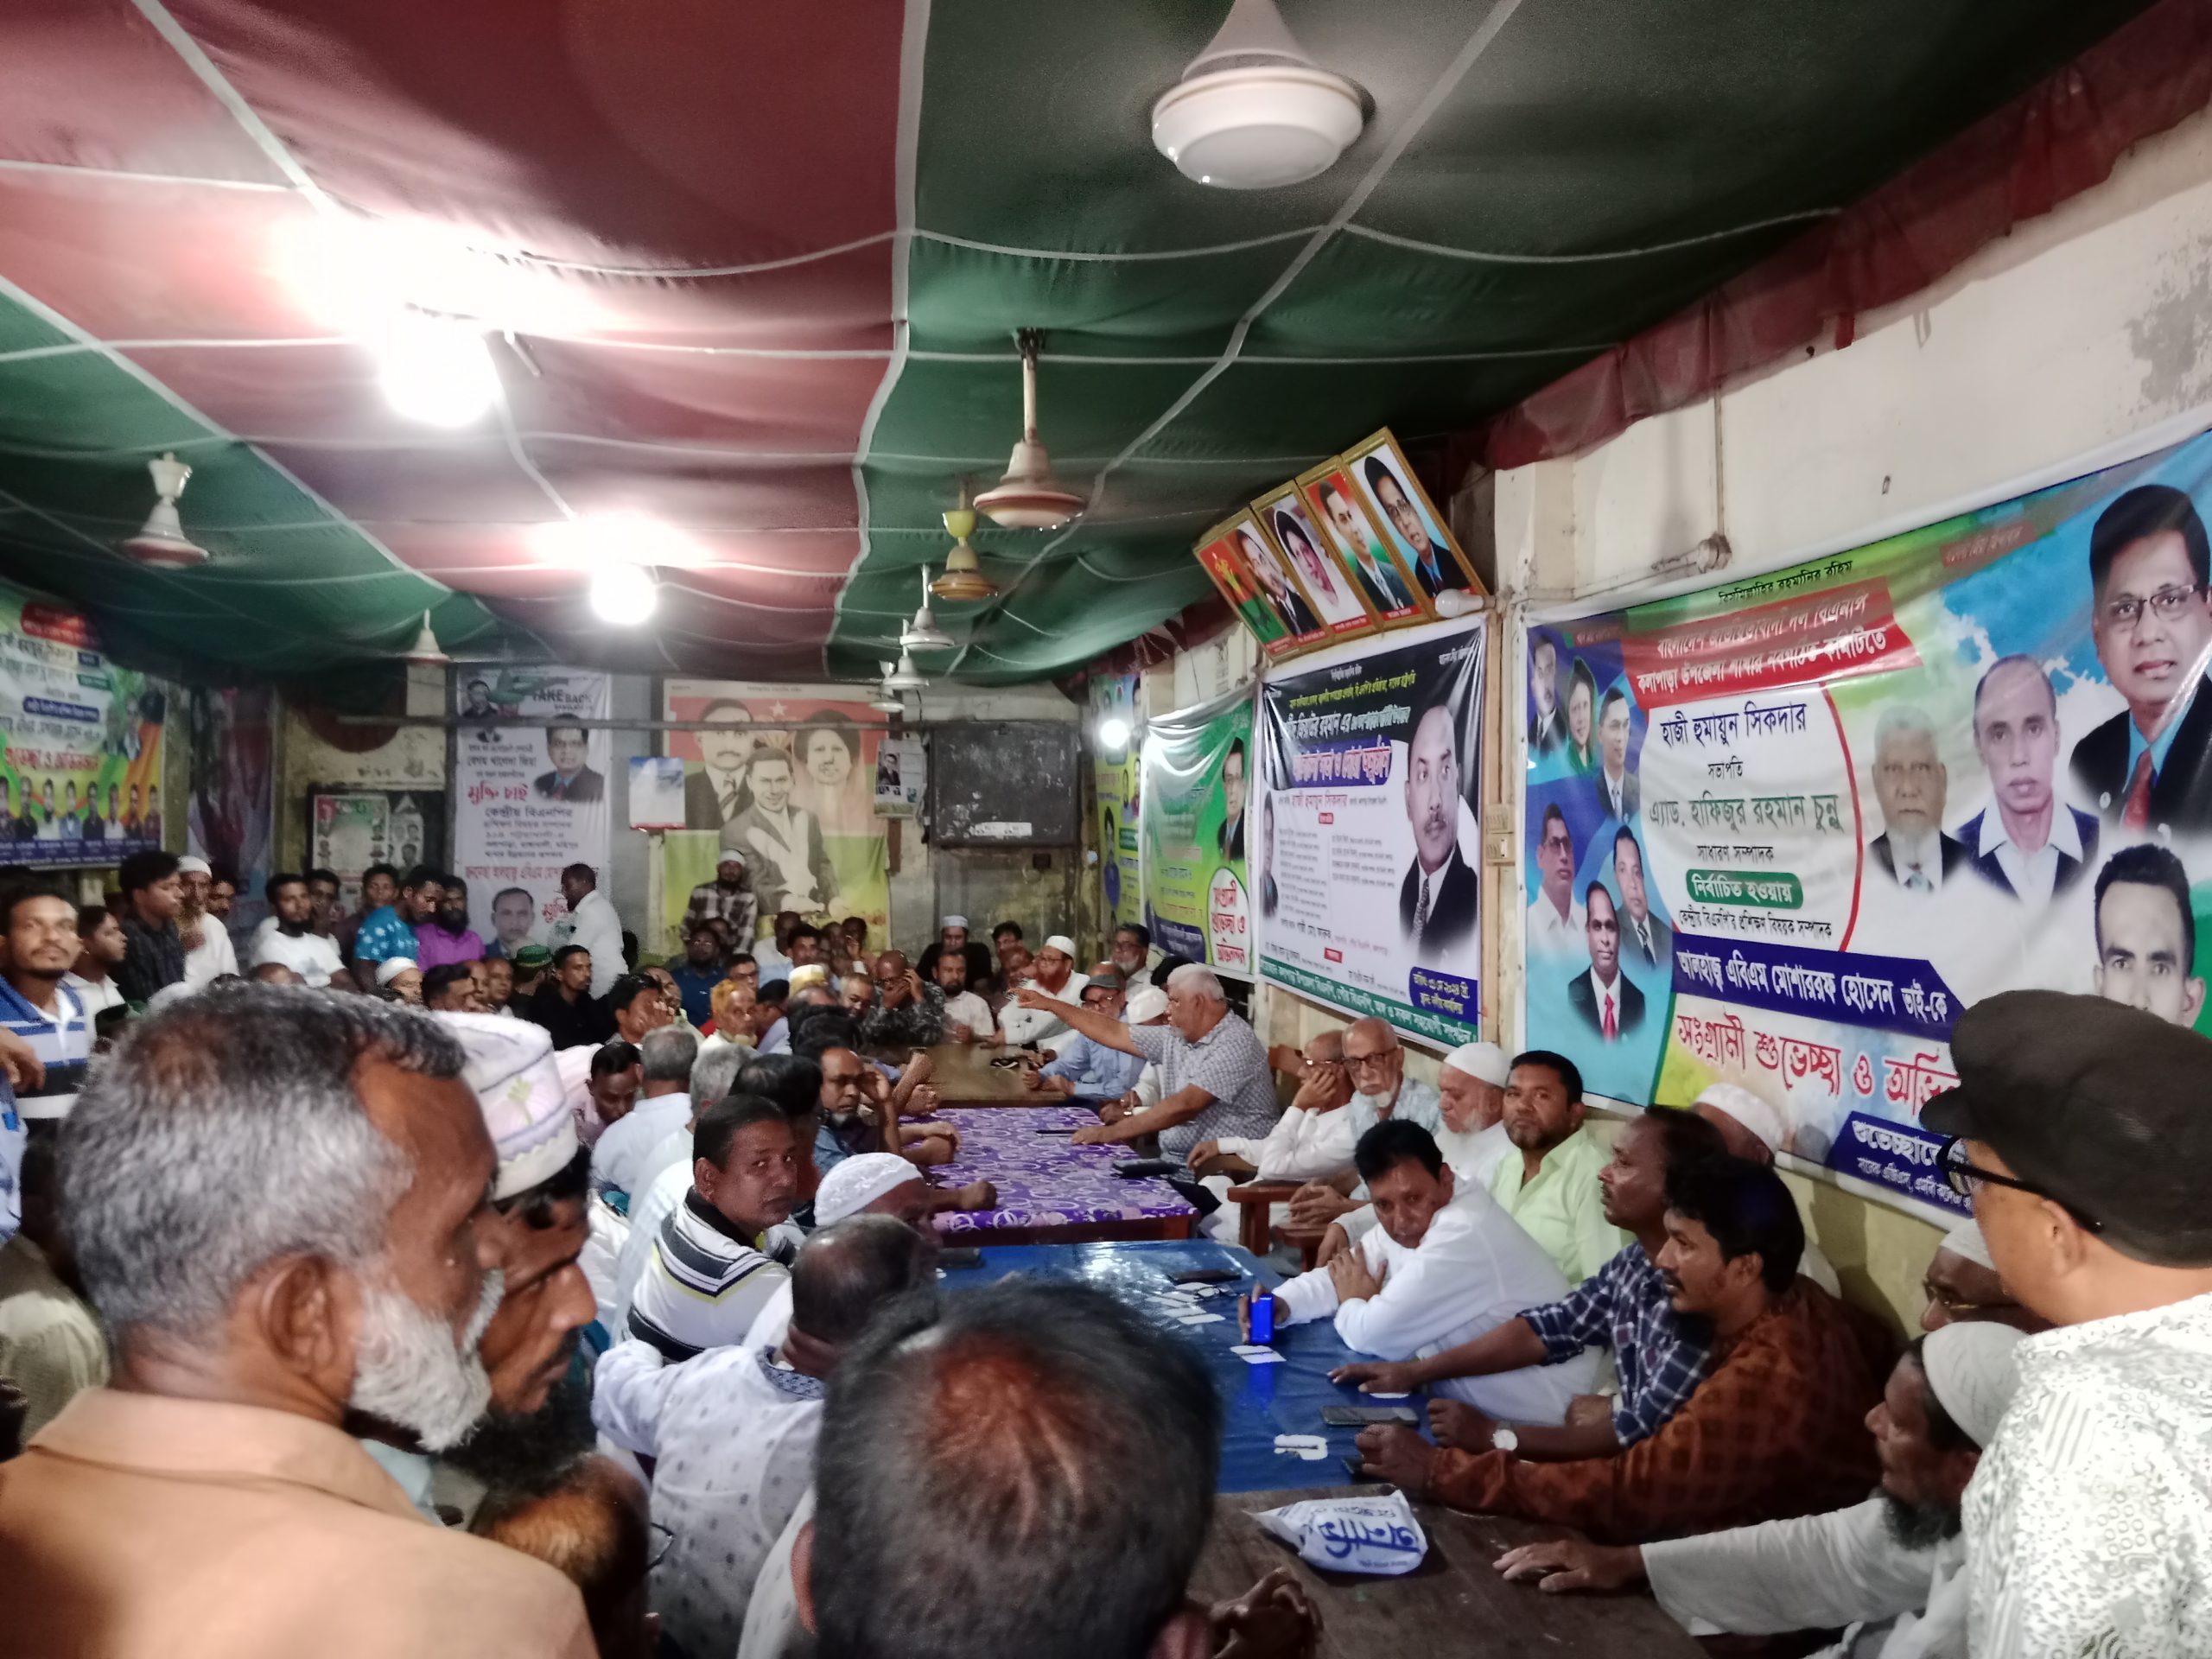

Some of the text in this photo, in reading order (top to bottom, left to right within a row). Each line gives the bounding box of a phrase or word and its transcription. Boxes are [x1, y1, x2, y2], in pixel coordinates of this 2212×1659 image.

[1660, 700, 1808, 748] হাজী হুমায়ুন সিকদার
[1707, 755, 1744, 781] সভাপতি
[504, 783, 528, 802] চাই
[1688, 790, 1746, 835] হাফিজুর
[1751, 792, 1806, 830] রহমান
[1696, 844, 1774, 864] সাধারণ সম্পাদক
[1691, 872, 1793, 904] নির্বাচিত হওয়ায়
[1797, 918, 1832, 941] সম্পাদক
[1726, 949, 1770, 993] এবিএম
[1771, 962, 1836, 1005] মোশাররফ
[1840, 972, 1897, 1015] হোসেন
[1676, 1005, 1745, 1071] সংগ্রামী
[1752, 1031, 1842, 1097] শুভেচ্ছা
[1853, 1054, 1873, 1095] ও
